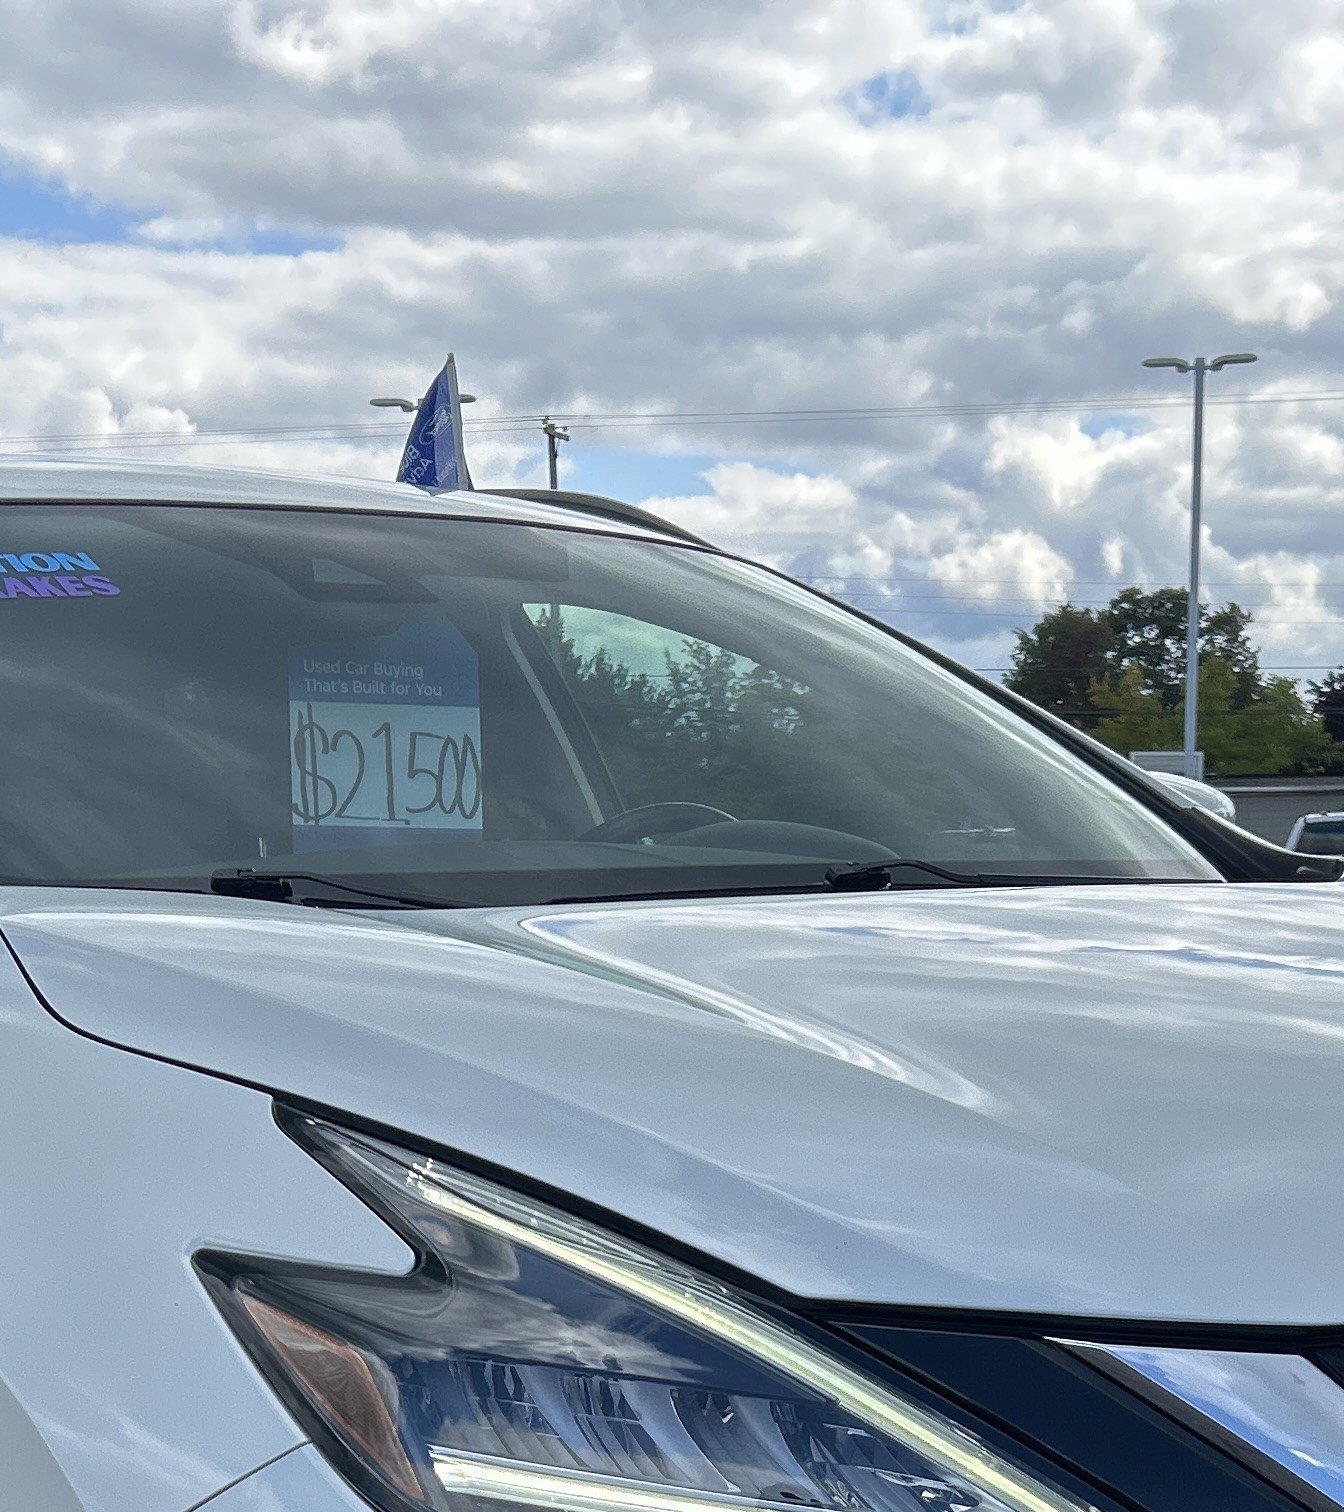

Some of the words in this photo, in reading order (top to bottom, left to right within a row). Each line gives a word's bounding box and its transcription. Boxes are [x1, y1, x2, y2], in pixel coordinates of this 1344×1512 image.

[303, 660, 340, 674] Used
[345, 661, 369, 674] Car
[373, 662, 424, 679] Buying
[305, 678, 348, 693] That's
[353, 680, 386, 694] Built
[390, 682, 411, 695] for
[416, 683, 443, 697] You
